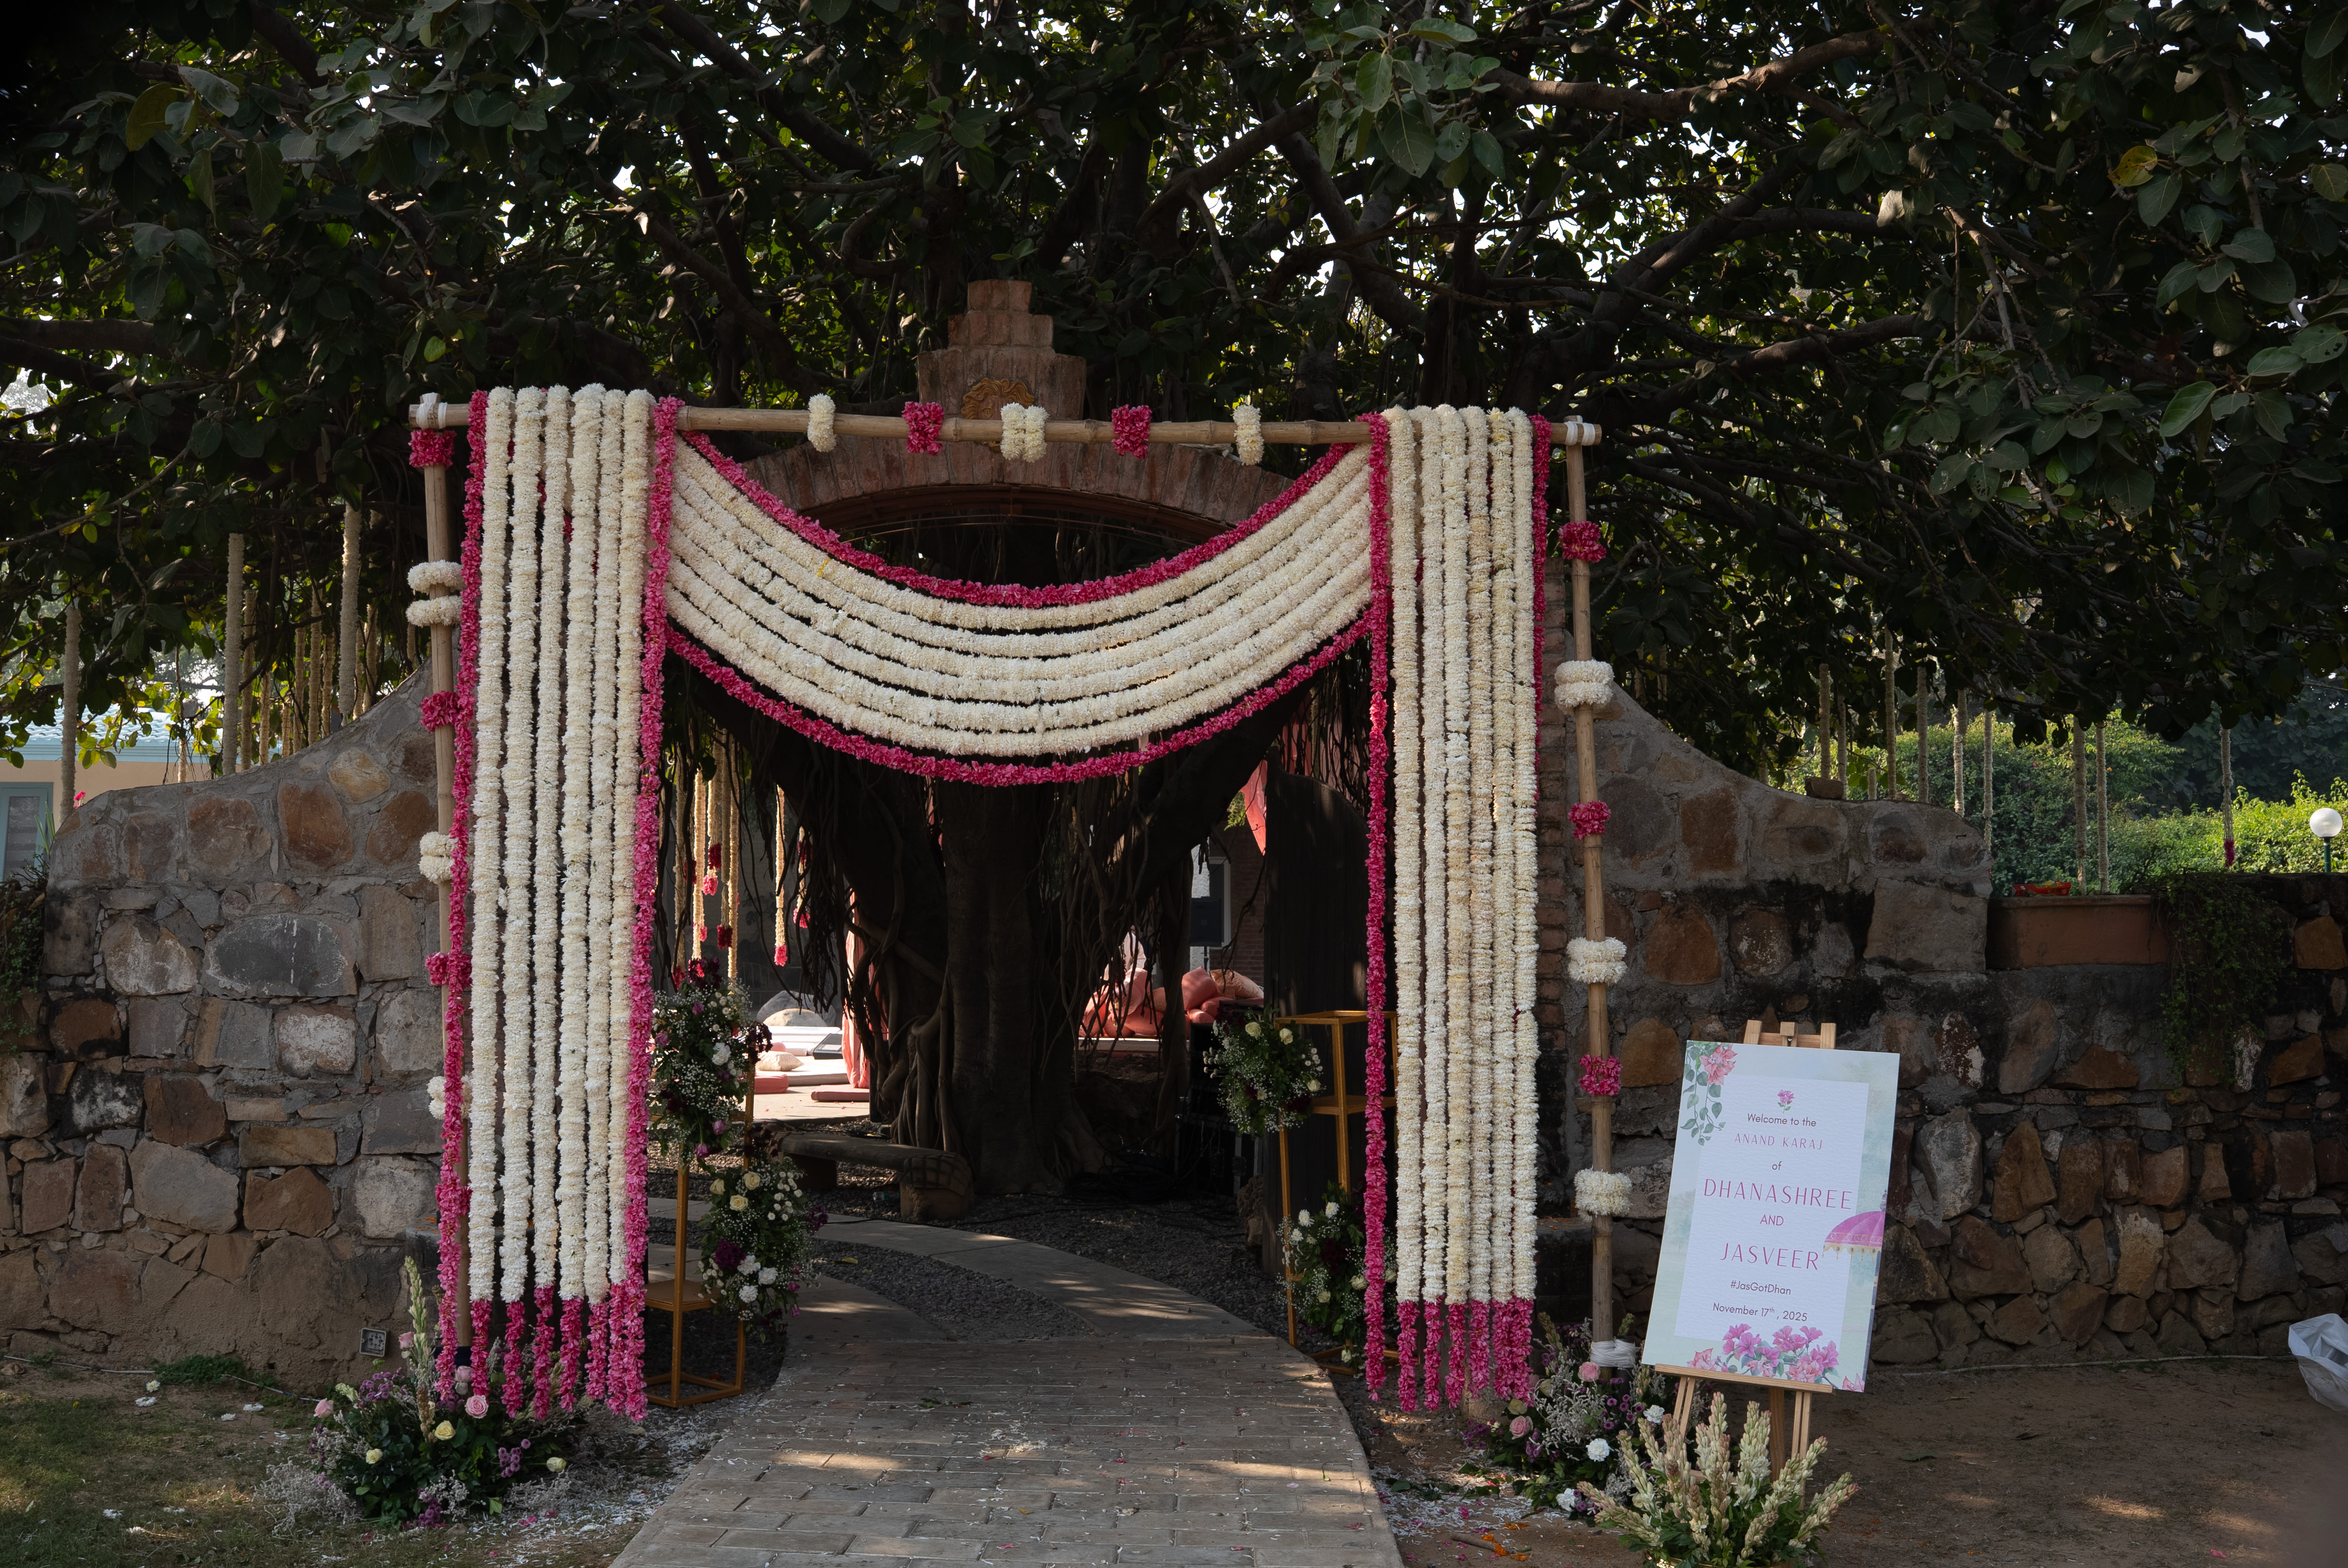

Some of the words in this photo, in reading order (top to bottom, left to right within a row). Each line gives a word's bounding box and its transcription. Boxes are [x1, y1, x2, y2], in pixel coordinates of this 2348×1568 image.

[1748, 1113, 1788, 1125] Welcome
[1790, 1117, 1799, 1126] to
[1802, 1117, 1816, 1127] the
[1734, 1133, 1775, 1146] ANAND
[1783, 1137, 1822, 1150] KARAJ
[1772, 1161, 1782, 1170] of
[1705, 1179, 1852, 1209] DHANASHREE
[1760, 1214, 1784, 1226] AND
[1720, 1243, 1818, 1270] JASVEER
[1731, 1280, 1791, 1294] #JasGotDhan
[1713, 1302, 1758, 1316] November
[1783, 1311, 1808, 1322] 2025
